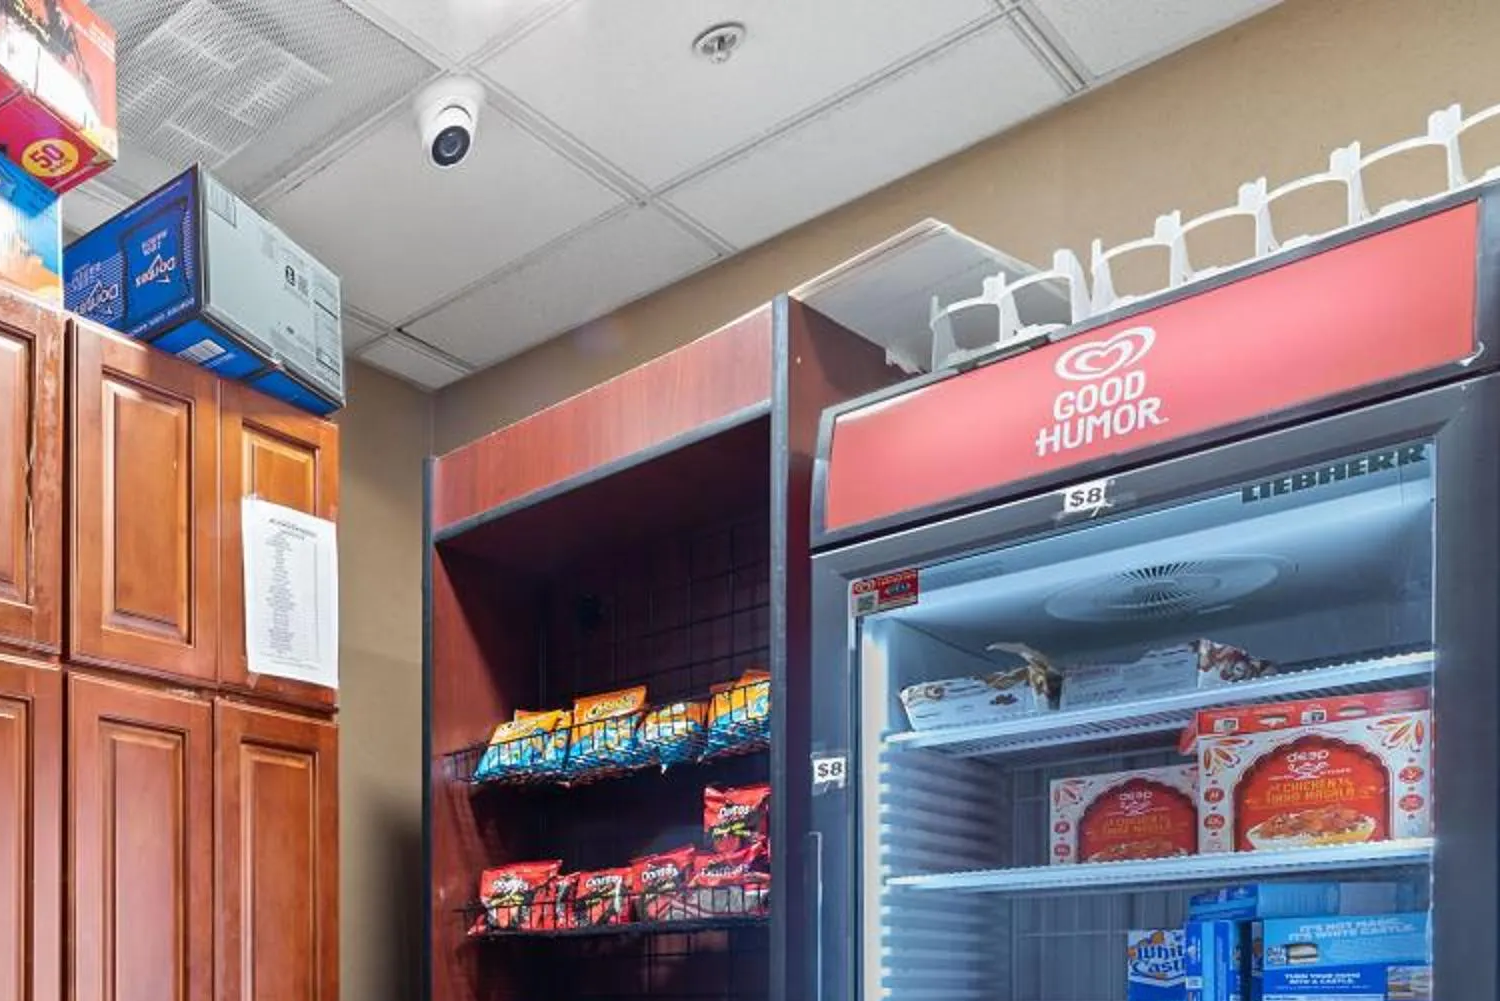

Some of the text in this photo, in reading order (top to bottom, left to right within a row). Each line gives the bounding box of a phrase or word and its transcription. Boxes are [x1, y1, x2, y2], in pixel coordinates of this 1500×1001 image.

[28, 143, 65, 169] 50
[1053, 369, 1146, 422] GOOD
[1035, 396, 1171, 458] HUMOR
[1242, 443, 1427, 503] LIEBHERR
[1070, 487, 1102, 508] $8
[817, 762, 842, 779] $8
